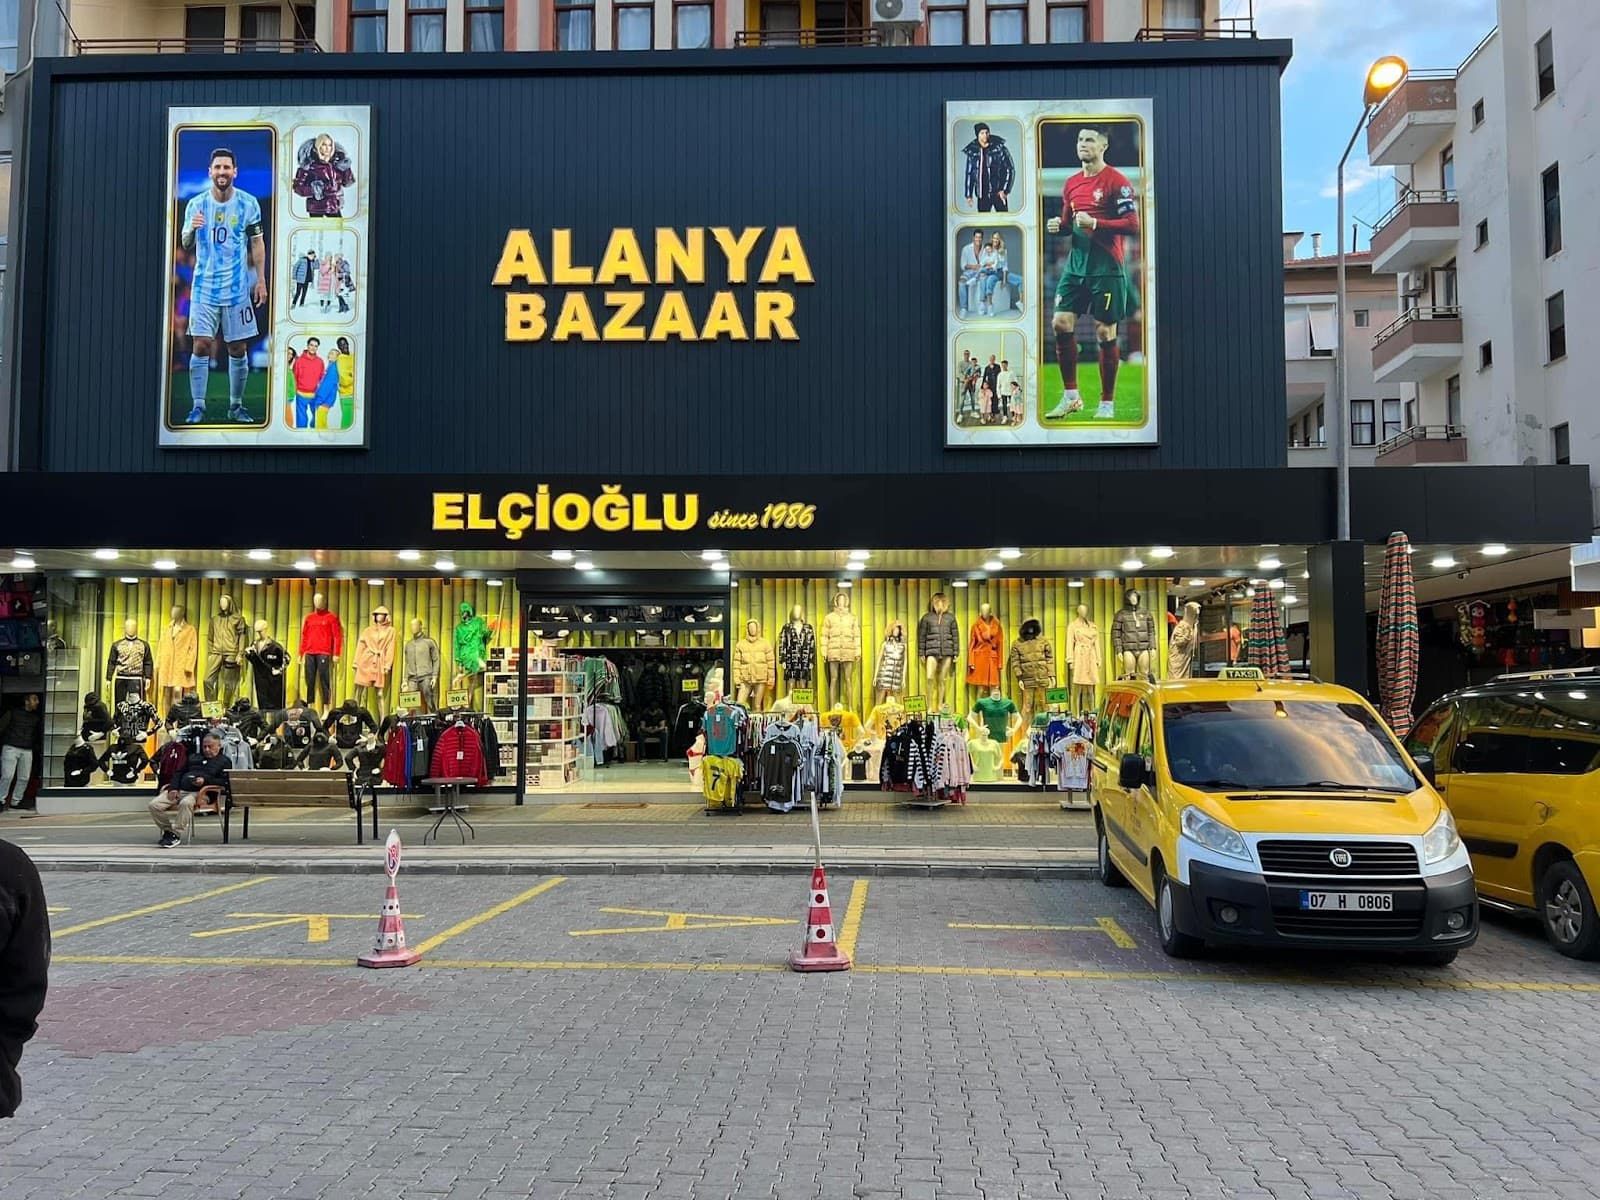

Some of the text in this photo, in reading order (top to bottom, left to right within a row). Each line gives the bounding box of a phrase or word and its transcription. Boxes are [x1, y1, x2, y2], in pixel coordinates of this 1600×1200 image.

[212, 226, 228, 245] 10
[493, 227, 815, 285] ALANYA
[1104, 292, 1112, 311] 7
[240, 307, 254, 325] 10
[504, 290, 800, 342] BAZAAR
[432, 484, 817, 540] ELÇİOĞLU since 1986
[1228, 670, 1257, 679] TAKSI
[712, 773, 720, 791] 7
[1310, 894, 1391, 910] 07 H 0806
